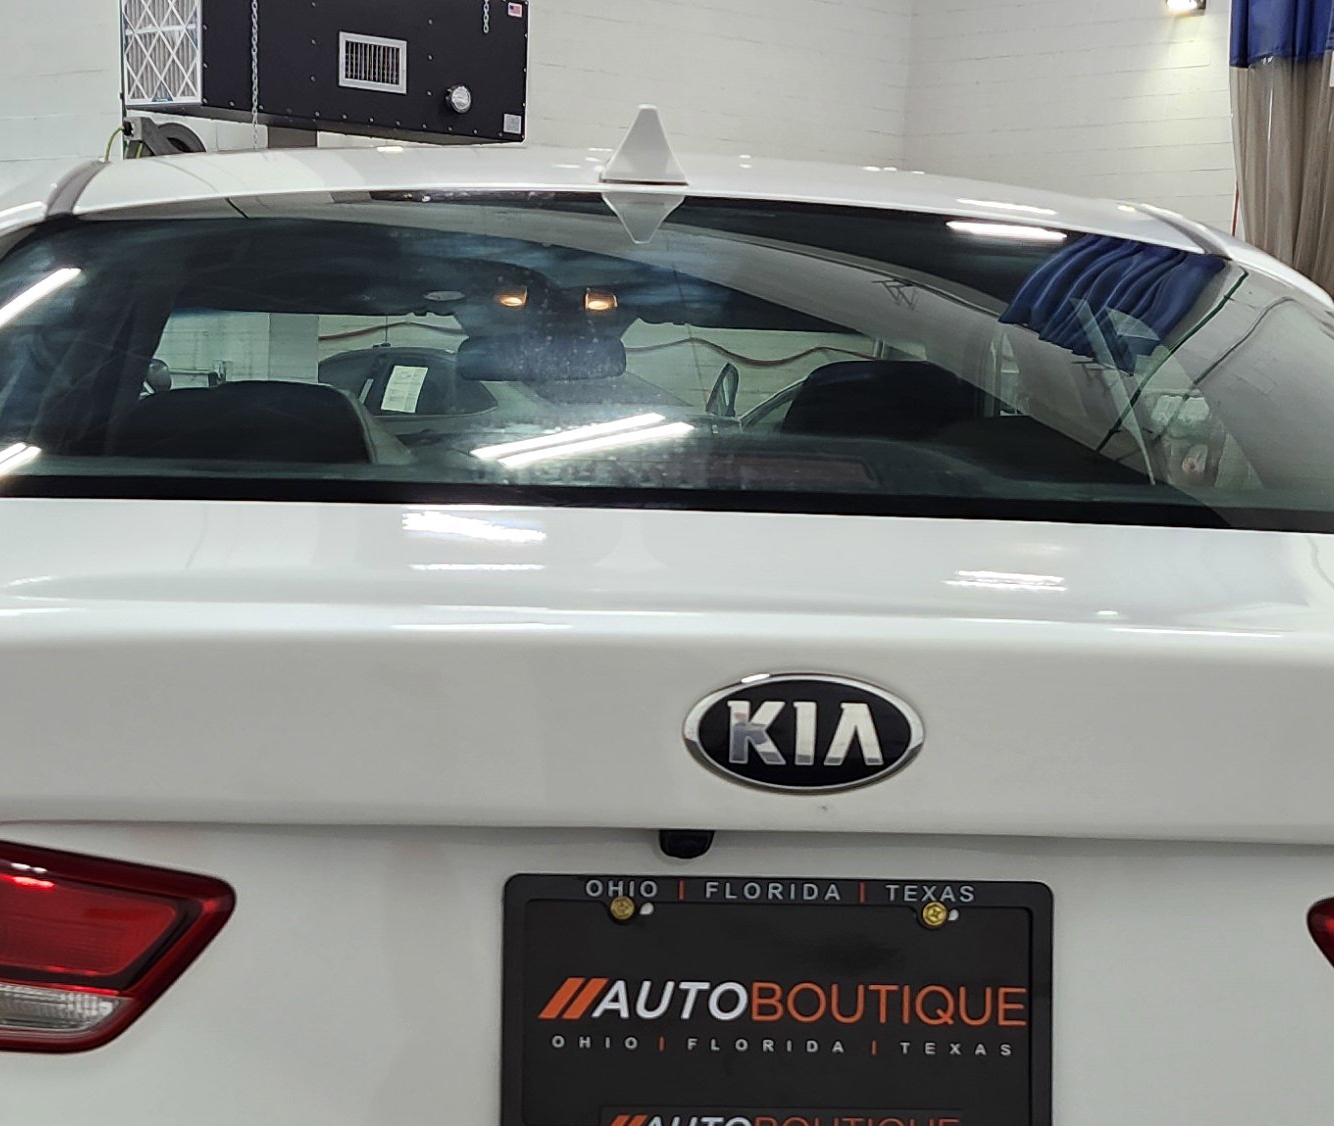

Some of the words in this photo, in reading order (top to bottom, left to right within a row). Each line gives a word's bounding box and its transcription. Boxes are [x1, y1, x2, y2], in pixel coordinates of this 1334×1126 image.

[727, 700, 884, 766] KIA
[586, 879, 658, 898] OHIO
[705, 882, 841, 900] FLORIDA
[886, 885, 975, 902] TEXAS
[552, 1035, 638, 1050] OHIO
[687, 1037, 844, 1054] FLORIDA
[901, 1042, 1012, 1056] TEXAS
